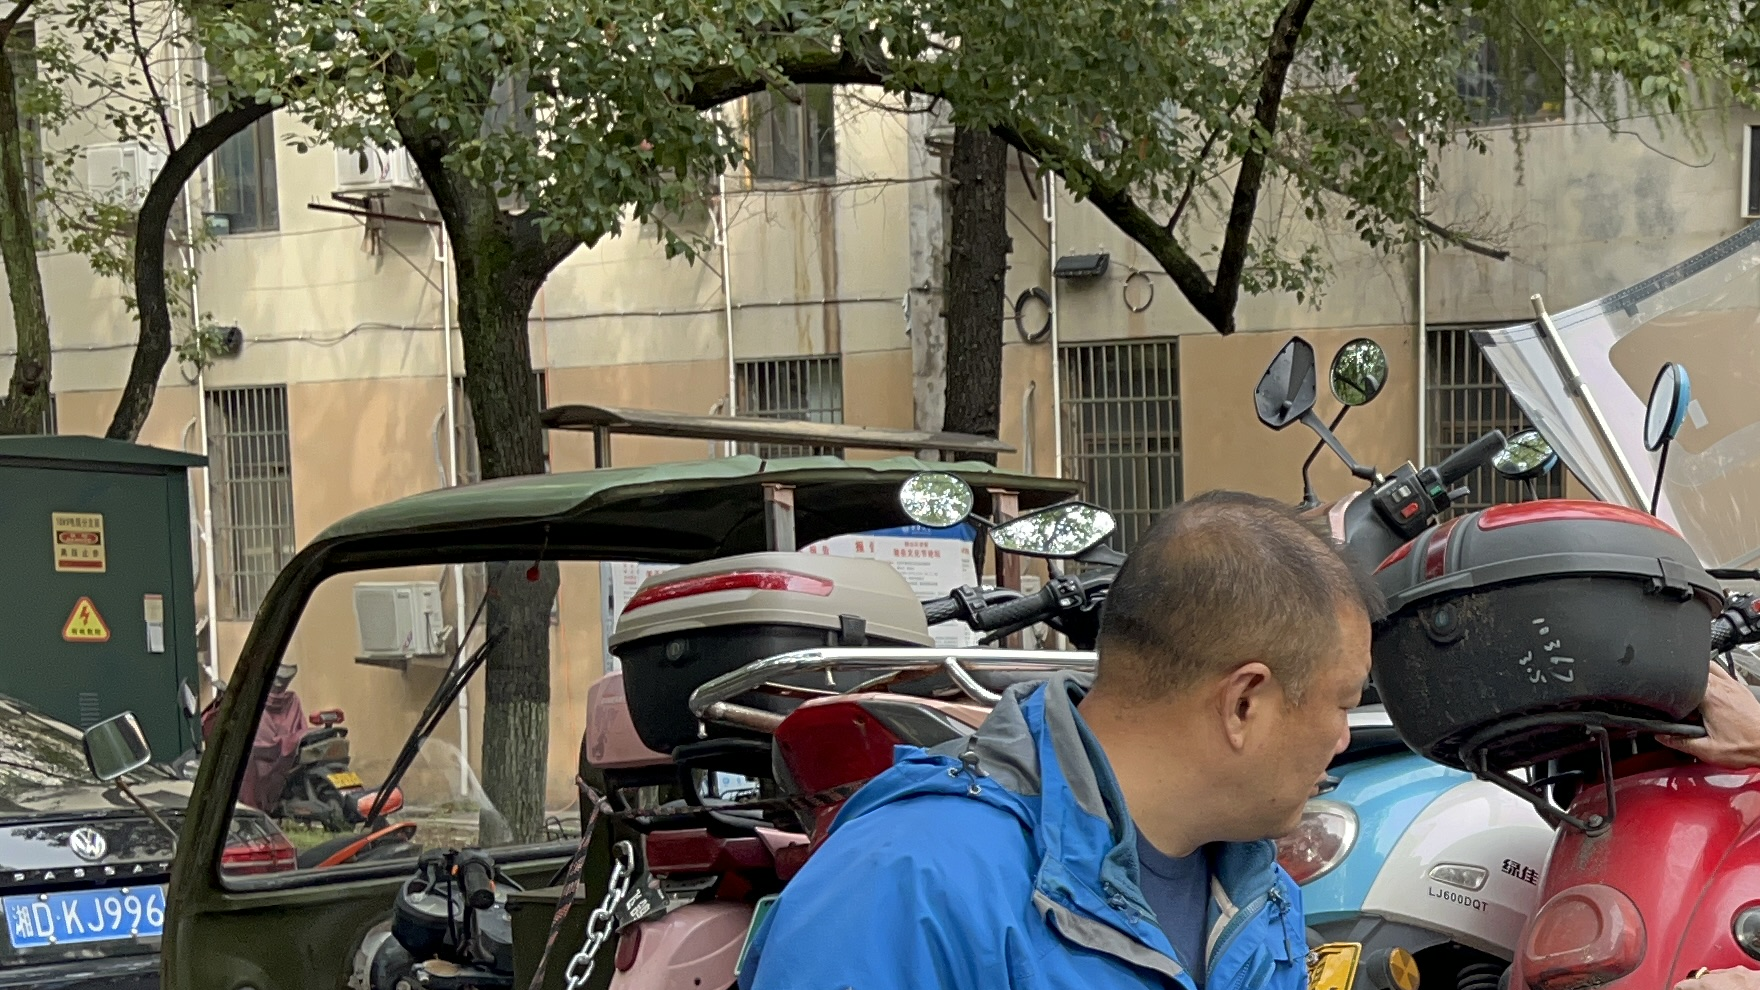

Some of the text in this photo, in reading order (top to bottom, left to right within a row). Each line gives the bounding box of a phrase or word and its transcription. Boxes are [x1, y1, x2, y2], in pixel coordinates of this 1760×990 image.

[13, 862, 170, 883] PASSAT
[1501, 858, 1540, 887] 绿佳
[1428, 886, 1489, 912] LJ600DQT
